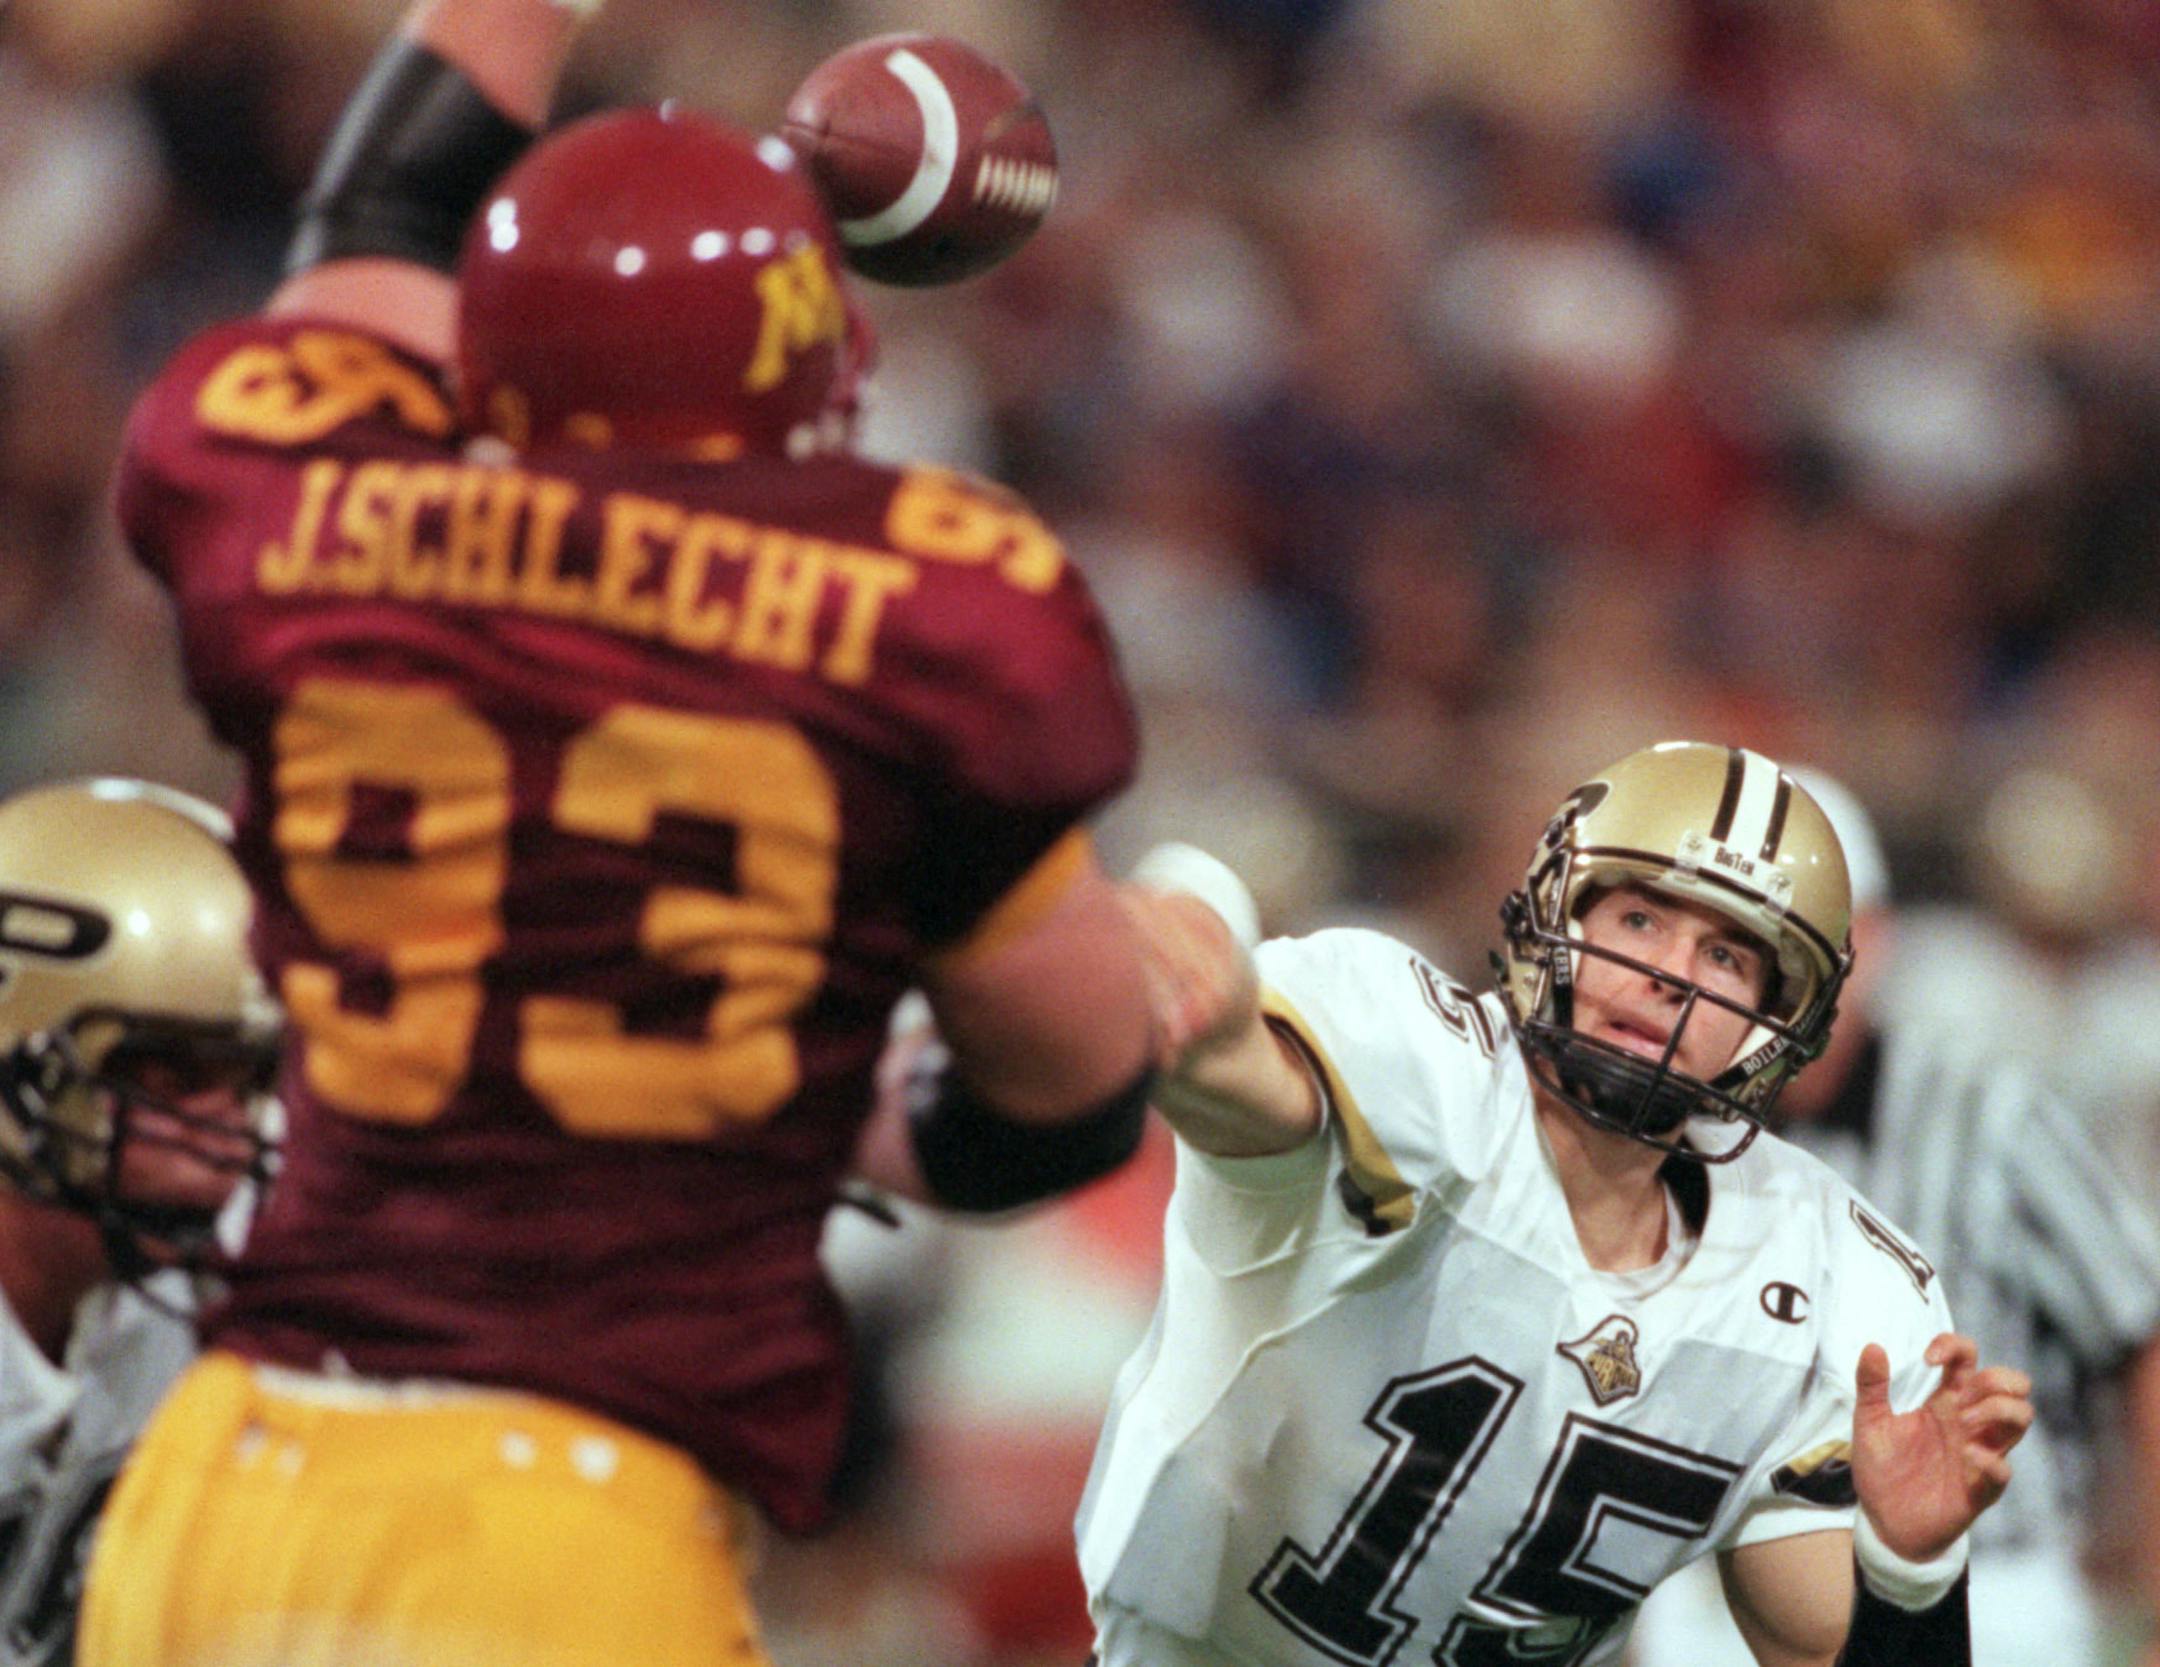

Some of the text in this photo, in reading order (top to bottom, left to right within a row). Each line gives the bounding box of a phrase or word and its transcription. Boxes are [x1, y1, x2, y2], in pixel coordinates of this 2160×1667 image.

[256, 458, 918, 686] J.SCHLECHT
[273, 676, 840, 1140] 93
[1248, 1355, 1748, 1667] 15
